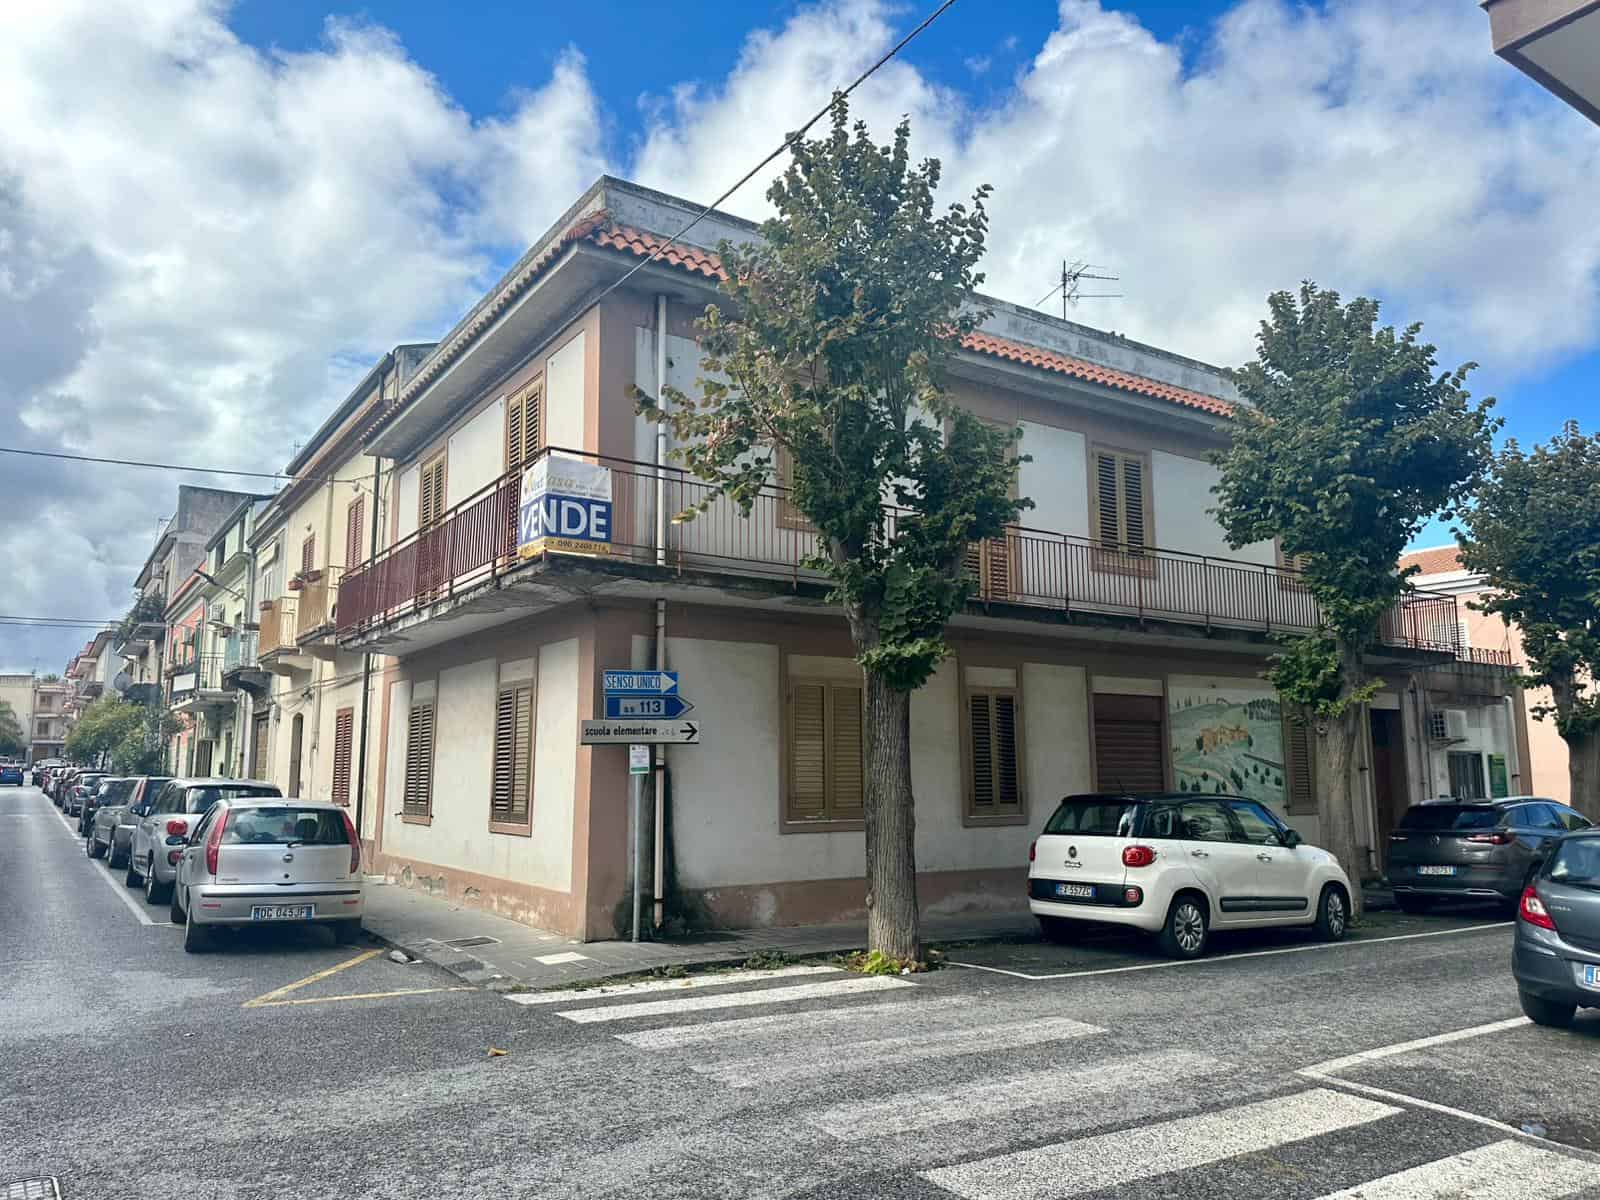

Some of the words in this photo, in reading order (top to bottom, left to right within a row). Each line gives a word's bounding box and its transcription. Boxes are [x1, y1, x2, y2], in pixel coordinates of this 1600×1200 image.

[521, 499, 607, 544] VENDE
[607, 675, 634, 689] SENSO
[637, 676, 661, 689] UNICO
[640, 700, 661, 713] 113
[584, 725, 611, 736] scuola
[613, 724, 657, 736] elementare
